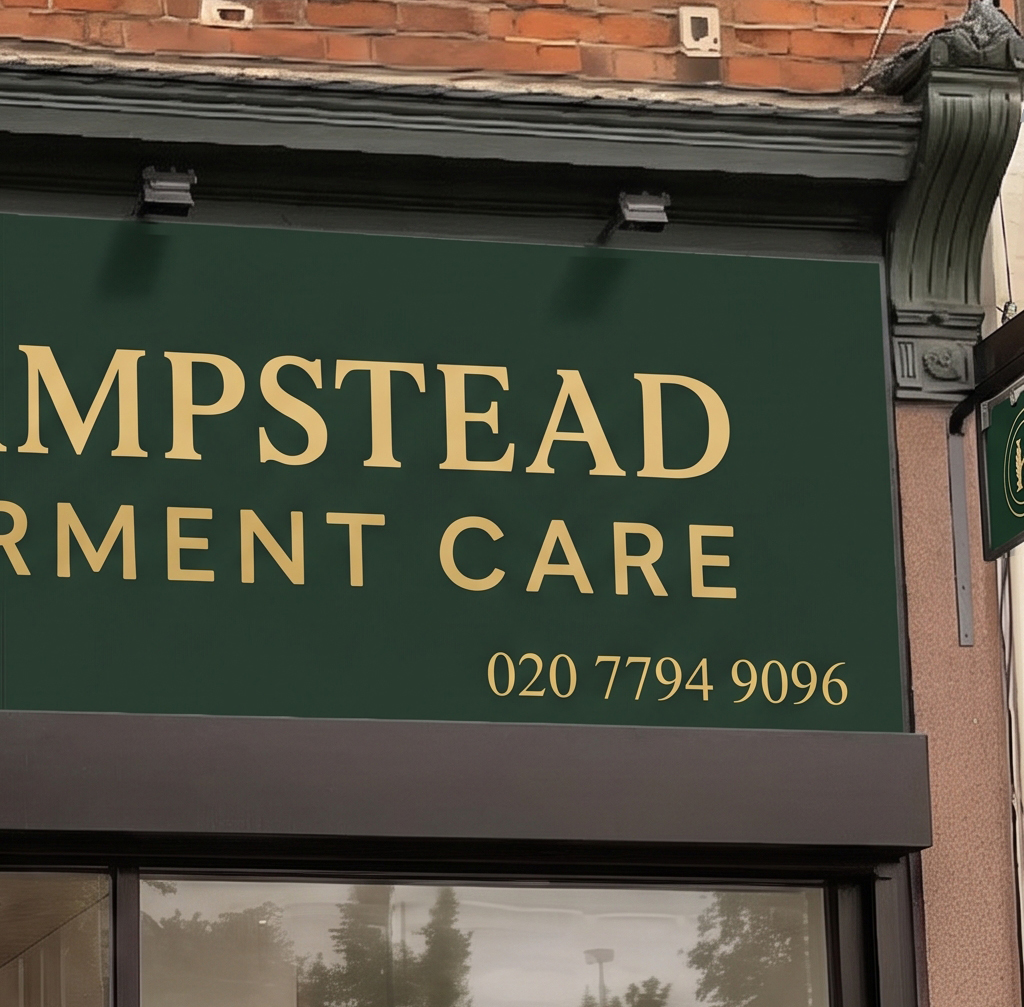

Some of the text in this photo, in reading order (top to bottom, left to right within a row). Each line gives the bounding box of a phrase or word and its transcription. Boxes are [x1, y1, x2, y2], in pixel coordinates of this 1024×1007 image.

[439, 515, 737, 599] CARE
[486, 652, 849, 706] 020 7794 9096
